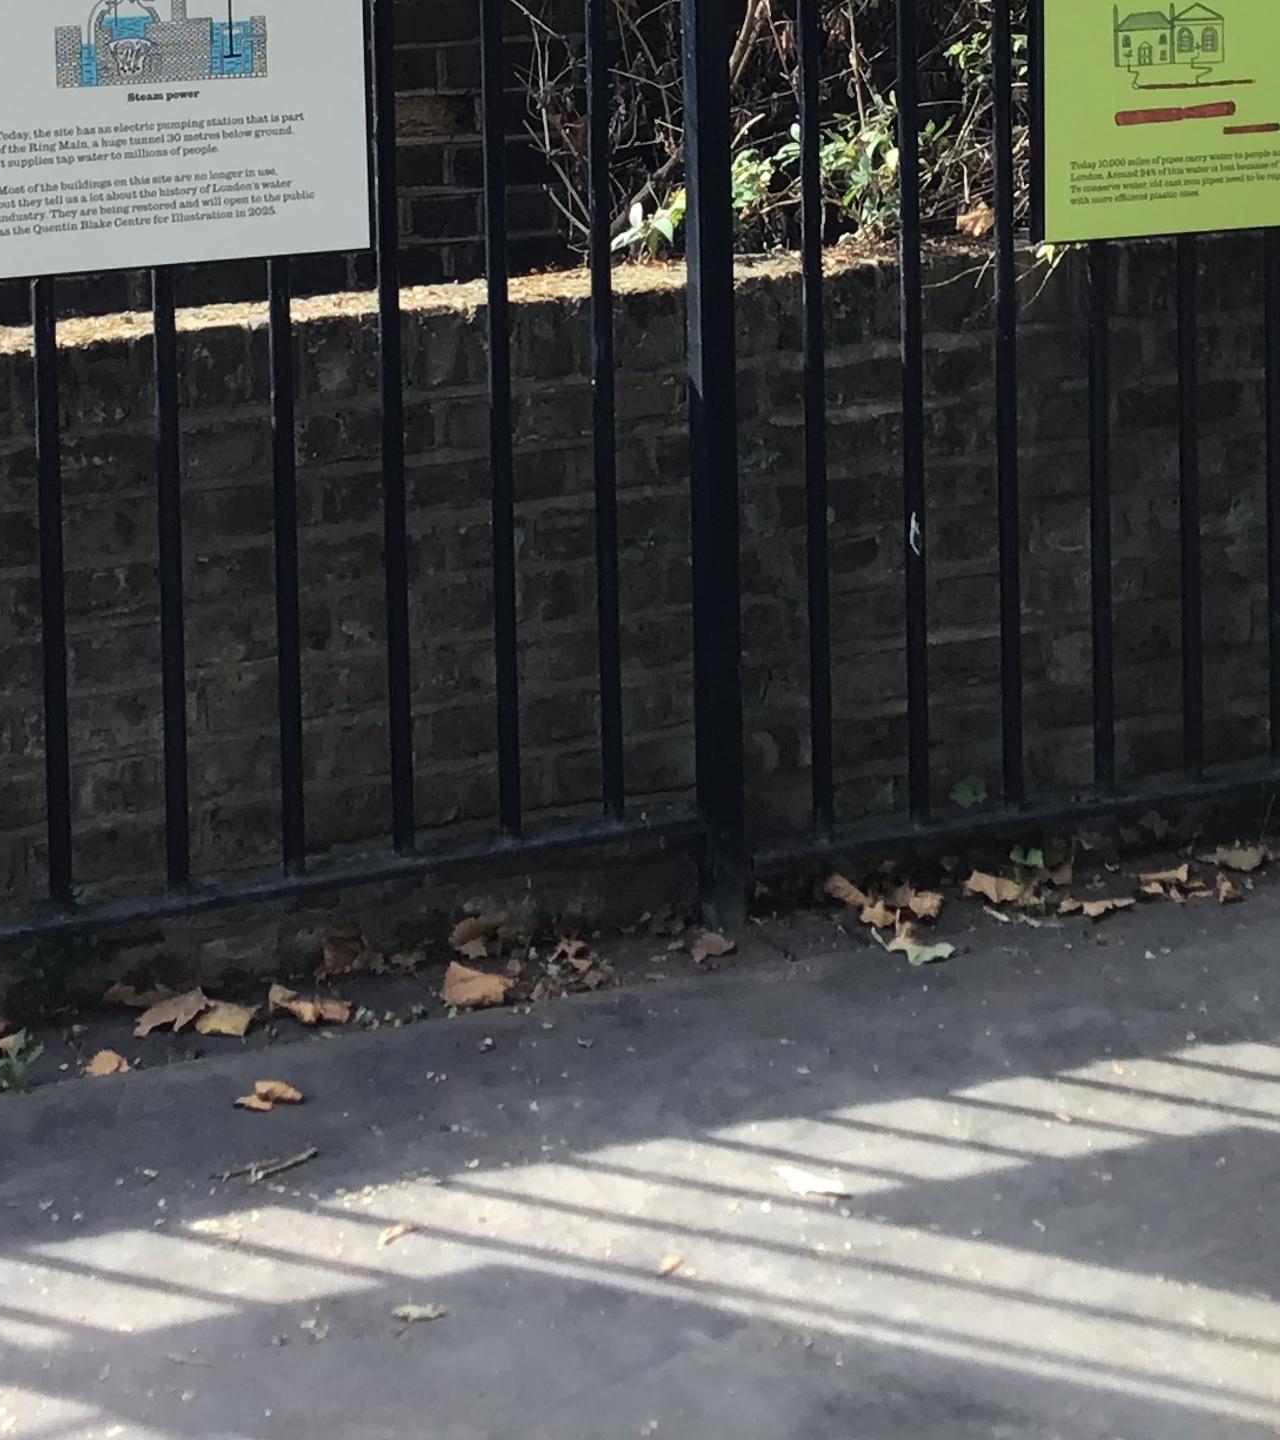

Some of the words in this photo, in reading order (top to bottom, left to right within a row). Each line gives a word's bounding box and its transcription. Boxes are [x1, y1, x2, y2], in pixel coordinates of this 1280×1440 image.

[127, 91, 164, 101] Steam
[165, 91, 200, 101] power
[12, 224, 31, 235] the
[32, 221, 78, 235] Quentin
[80, 218, 112, 230] Blake
[113, 215, 151, 227] Centre
[152, 214, 169, 224] for
[170, 209, 233, 223] Illustration
[234, 208, 246, 218] in
